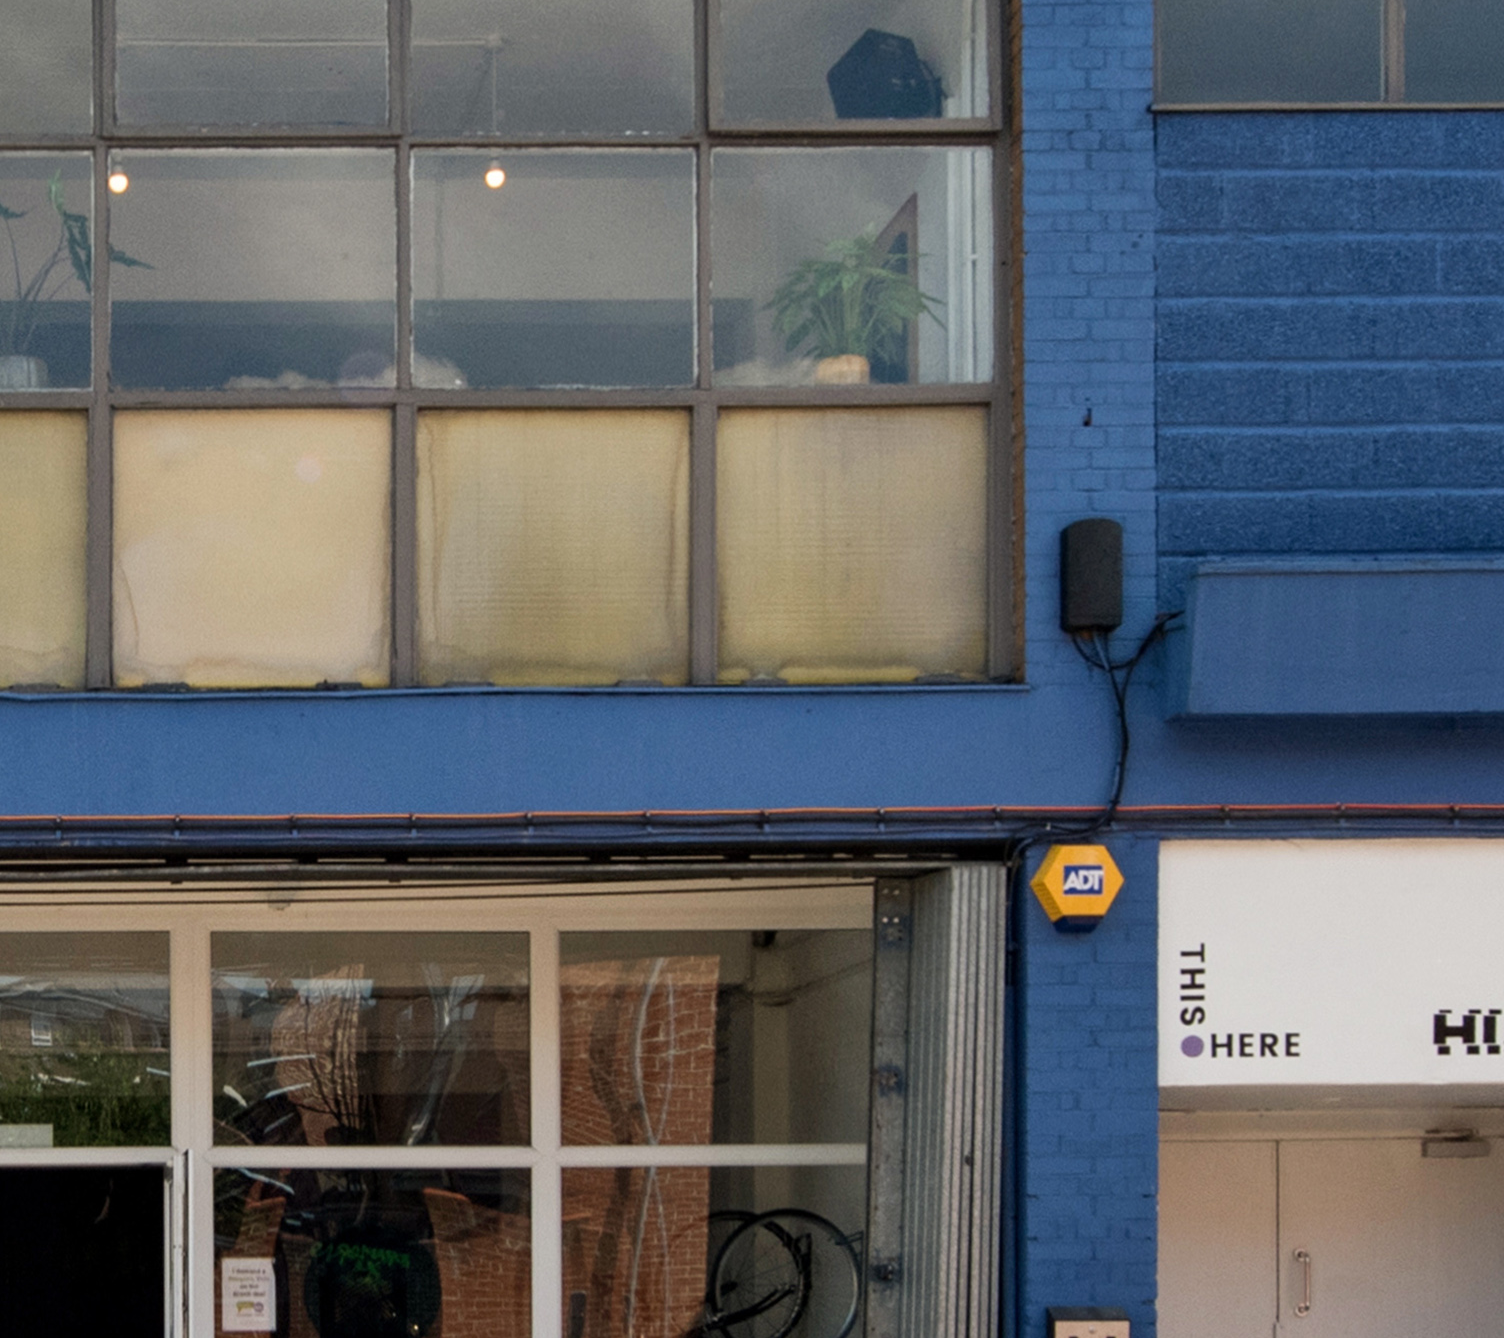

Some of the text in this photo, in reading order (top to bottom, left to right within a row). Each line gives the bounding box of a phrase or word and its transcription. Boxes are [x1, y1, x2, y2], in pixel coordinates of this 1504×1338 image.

[1063, 869, 1104, 891] ADT
[1179, 942, 1206, 1025] THIS
[1210, 1032, 1302, 1058] HERE
